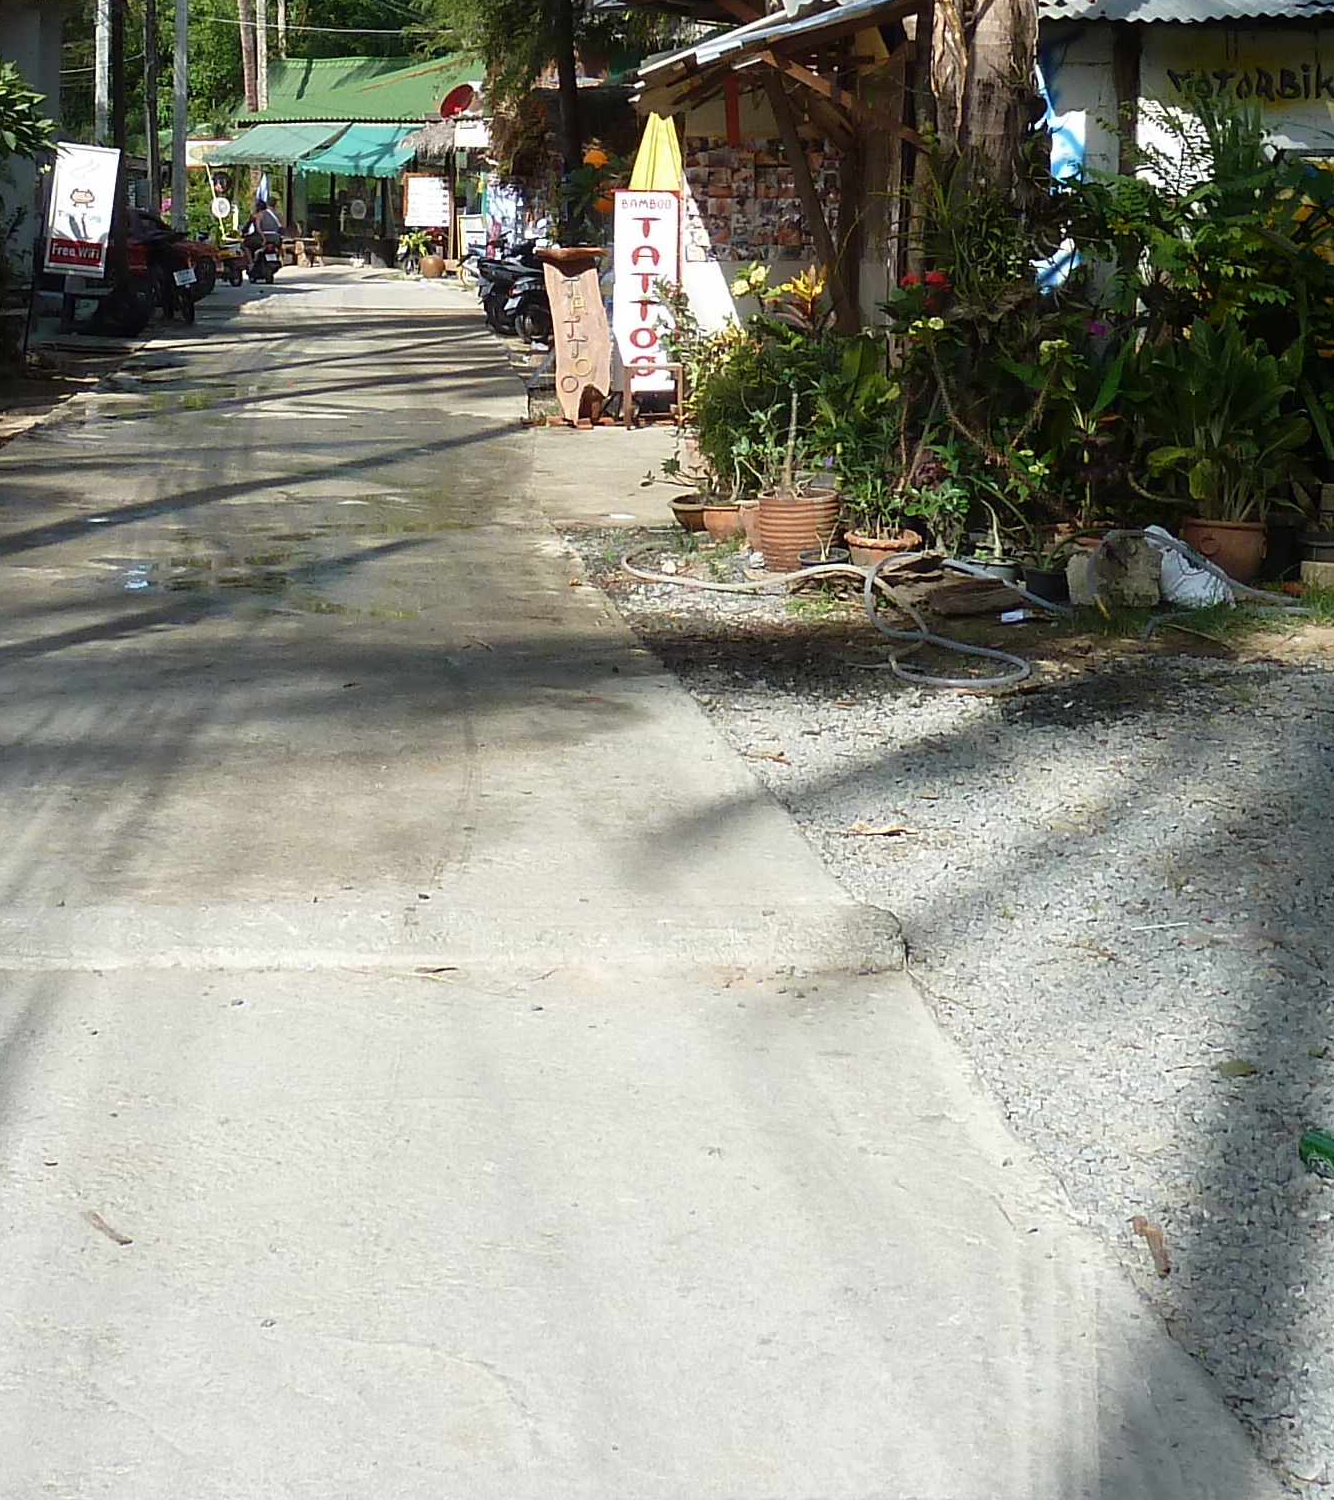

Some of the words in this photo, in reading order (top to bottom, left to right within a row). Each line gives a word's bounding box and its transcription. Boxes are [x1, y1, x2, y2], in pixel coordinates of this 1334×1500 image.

[621, 198, 671, 209] BAMBOO
[52, 243, 76, 257] Free
[561, 276, 593, 393] TATTOO
